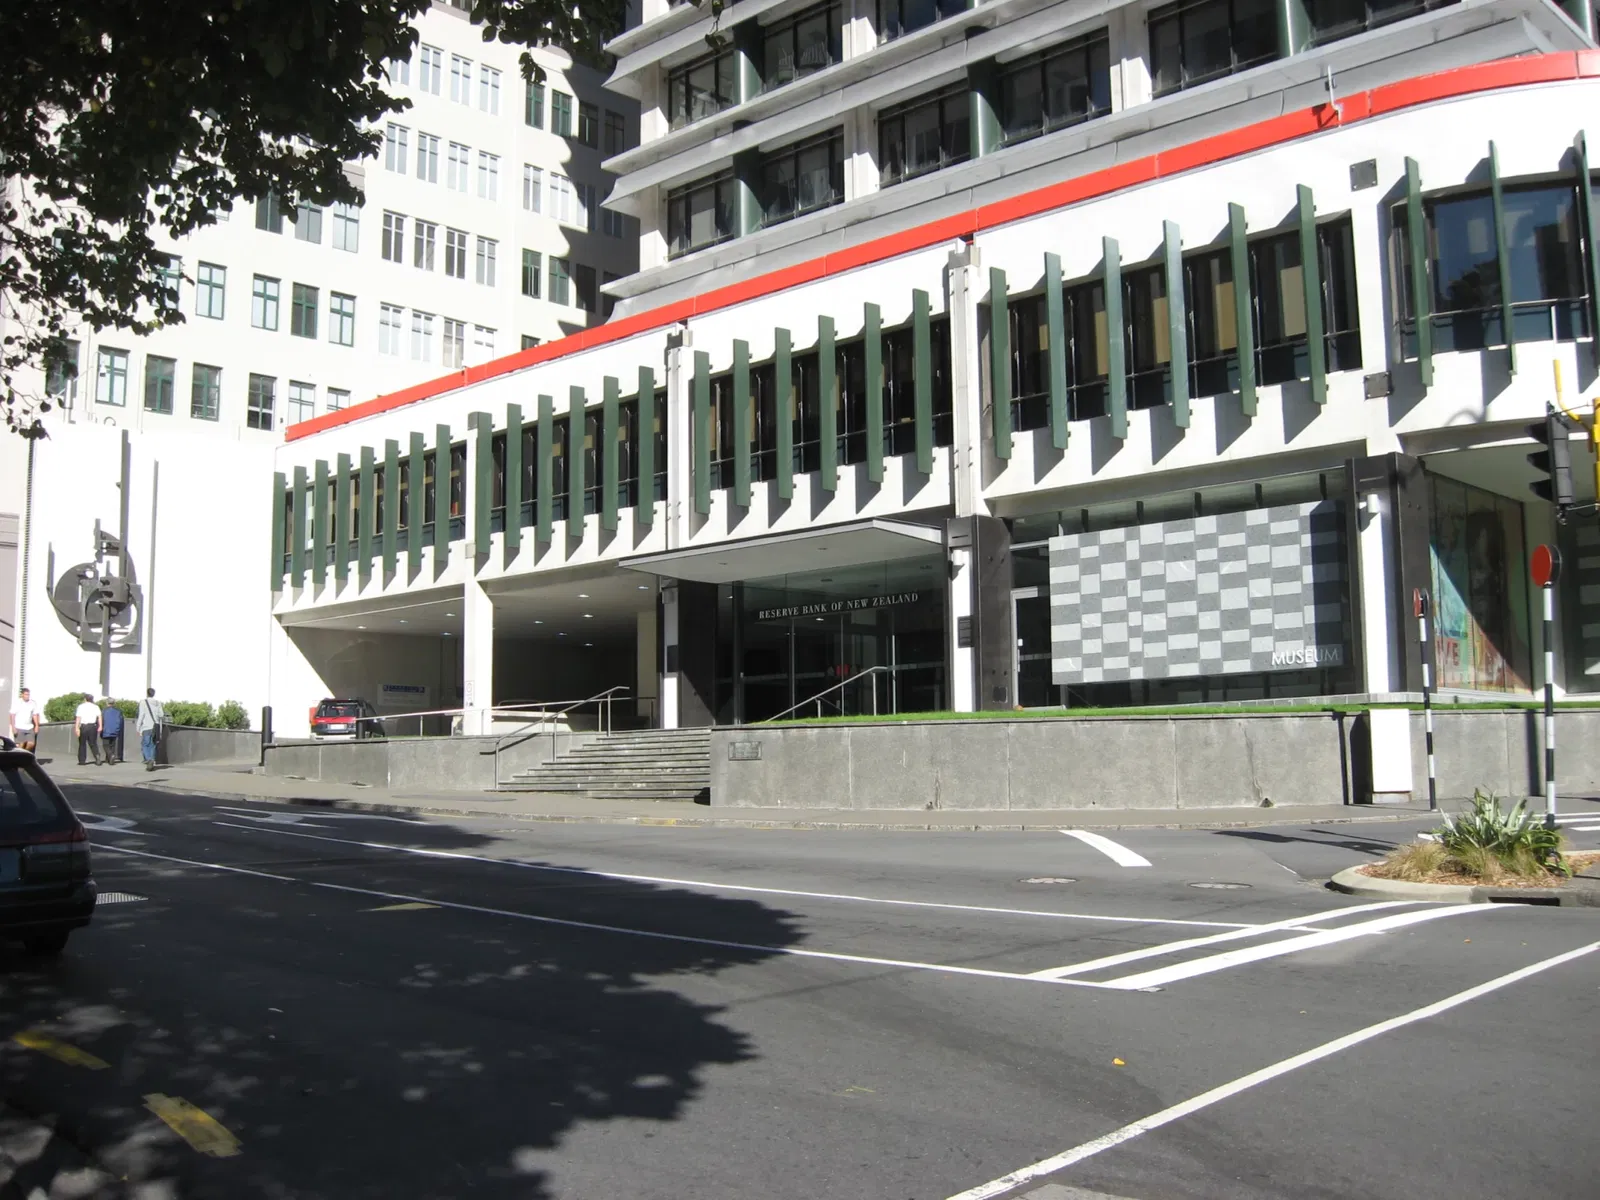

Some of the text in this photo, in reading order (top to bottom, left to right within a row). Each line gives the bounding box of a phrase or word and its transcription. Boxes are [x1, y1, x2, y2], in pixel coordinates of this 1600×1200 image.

[759, 592, 919, 619] RESERVE BANK OF NEW ZEALAND
[1271, 648, 1338, 666] MUSEUM
